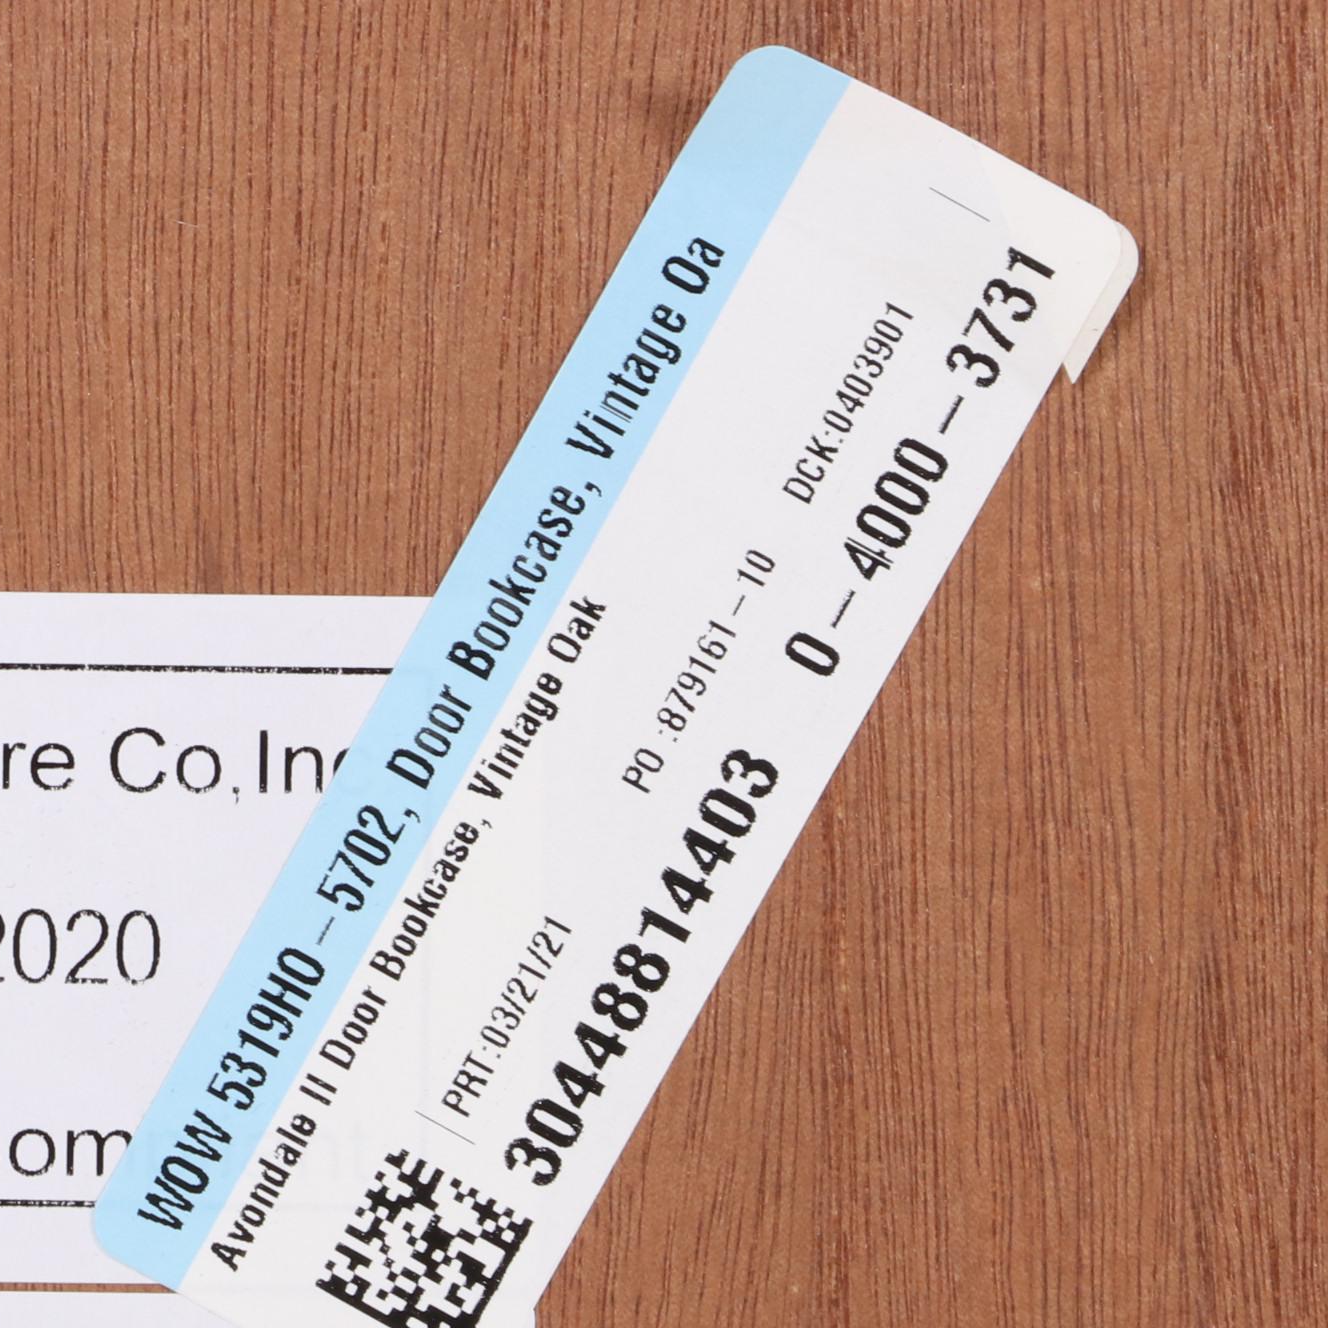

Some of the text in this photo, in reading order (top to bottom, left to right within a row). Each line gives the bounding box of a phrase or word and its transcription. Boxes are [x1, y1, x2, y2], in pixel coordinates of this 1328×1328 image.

[783, 303, 912, 504] DCK:0403901
[110, 727, 348, 804] Co,In
[137, 1110, 232, 1230] WOW
[386, 685, 471, 789] Door
[447, 482, 601, 680] Bookcase,
[566, 304, 686, 458] Vintage
[662, 238, 724, 294] Oa
[621, 747, 665, 794] PO
[211, 598, 605, 1271] Avondale II Door Bookcase, Vintage Oak
[443, 917, 571, 1116] PRT:03/21/21
[505, 750, 778, 1185] 30448814403
